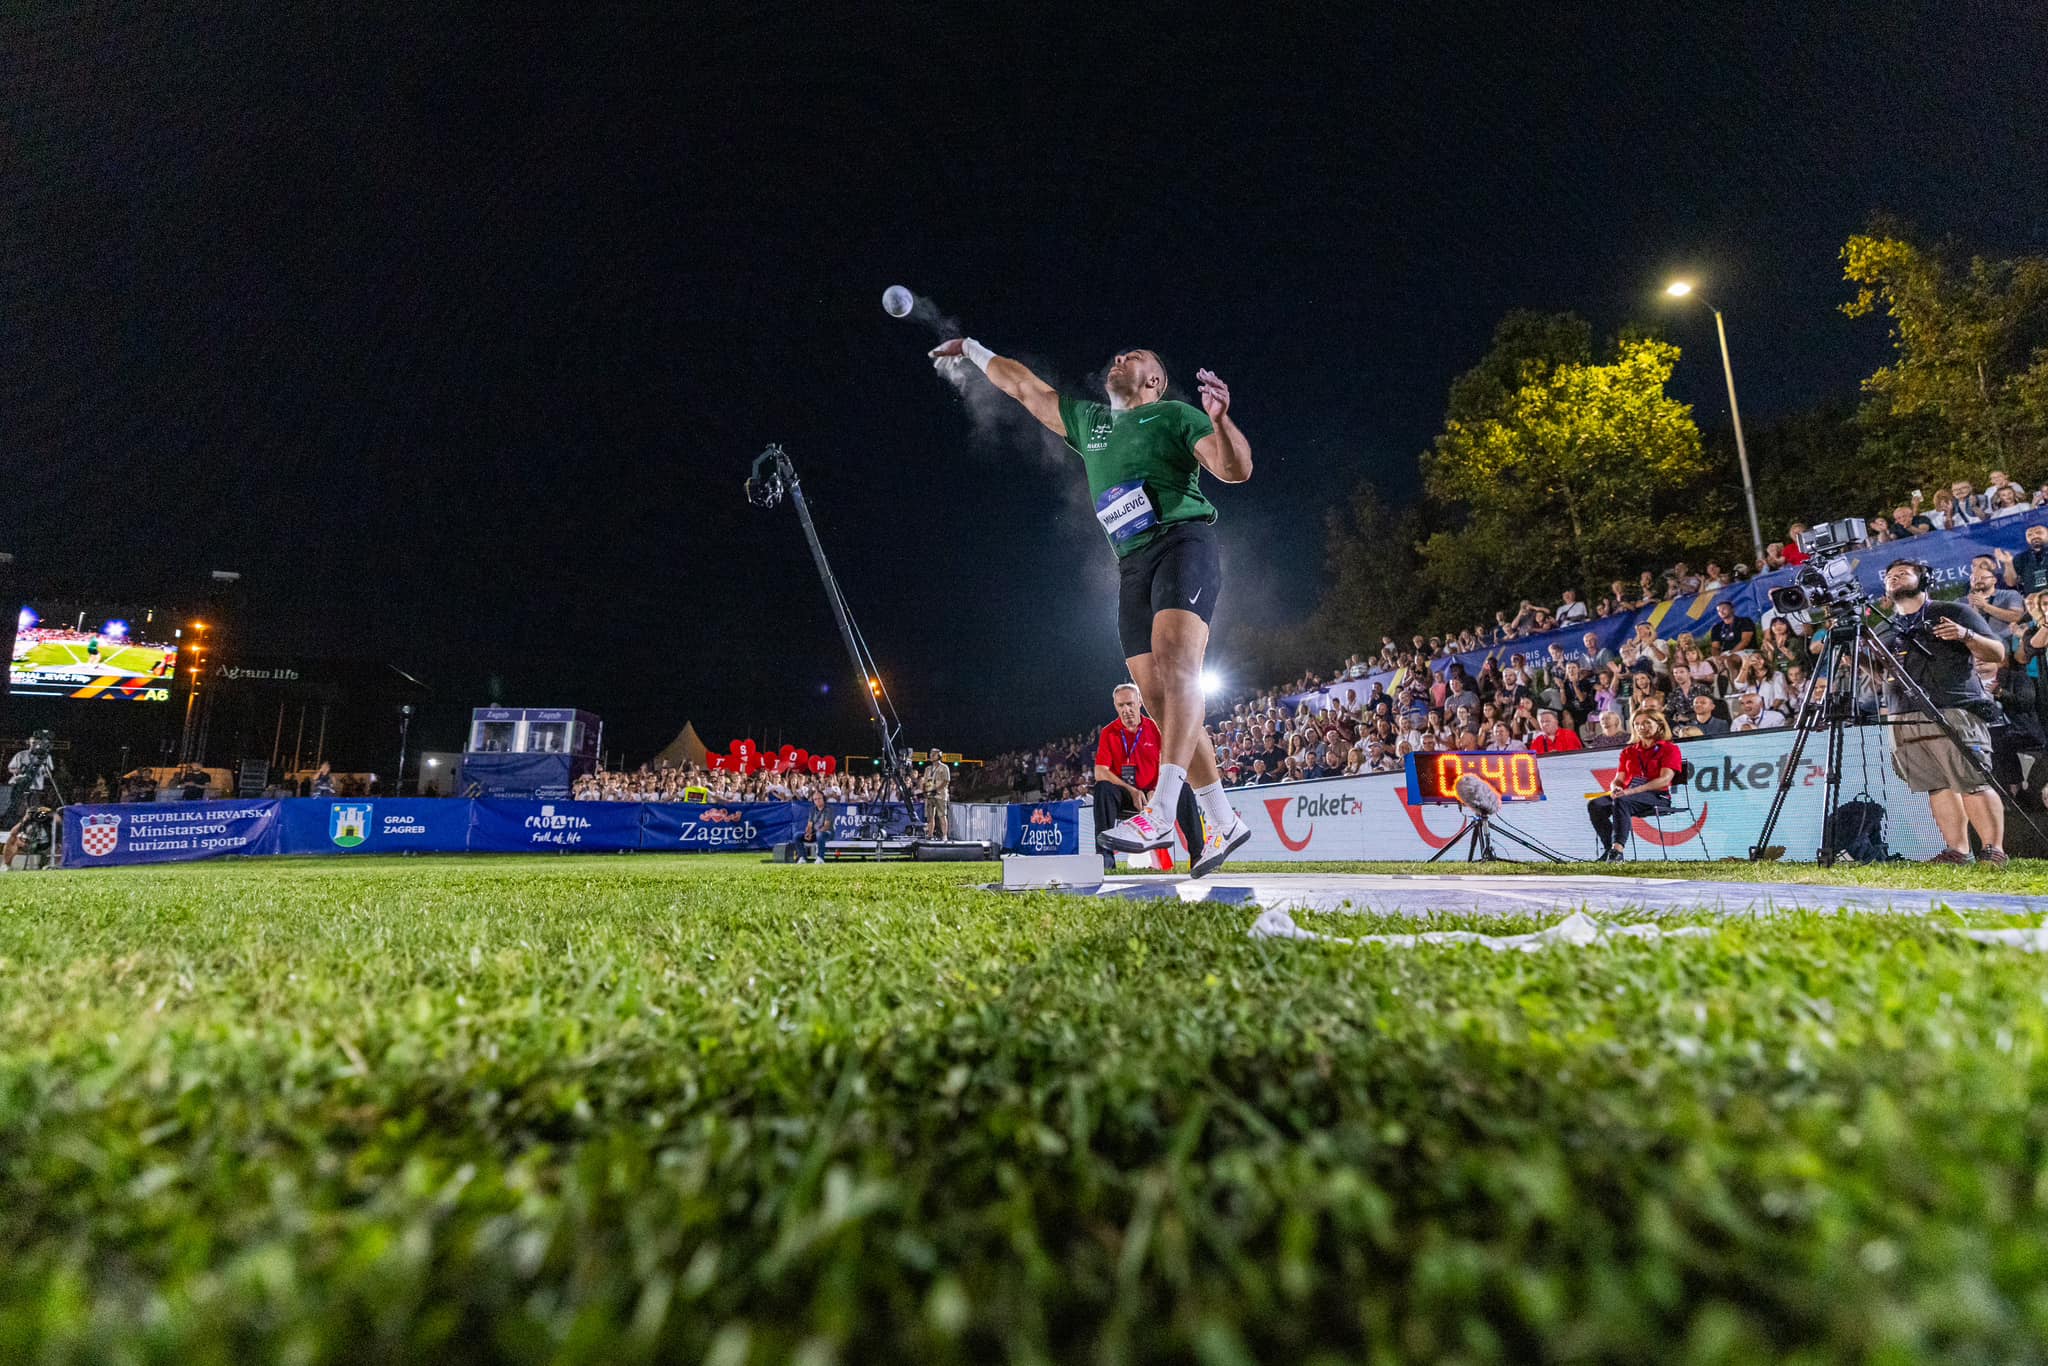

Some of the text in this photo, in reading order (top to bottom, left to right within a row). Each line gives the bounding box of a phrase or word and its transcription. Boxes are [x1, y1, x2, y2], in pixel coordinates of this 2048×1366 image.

[1103, 494, 1145, 526] MIHALJEVIĆ
[216, 664, 299, 679] Agram life
[144, 690, 169, 701] A6
[1297, 793, 1363, 818] Paket 24
[131, 808, 272, 823] REPUBLIKA HRVATSKA
[384, 816, 415, 824] GRAD
[525, 815, 591, 829] CROATIA
[130, 824, 226, 838] Ministarstvo
[383, 825, 426, 834] ZAGREB
[680, 820, 757, 845] Zagreb
[1021, 822, 1062, 851] Zagreb
[129, 836, 247, 852] turizma i sporta
